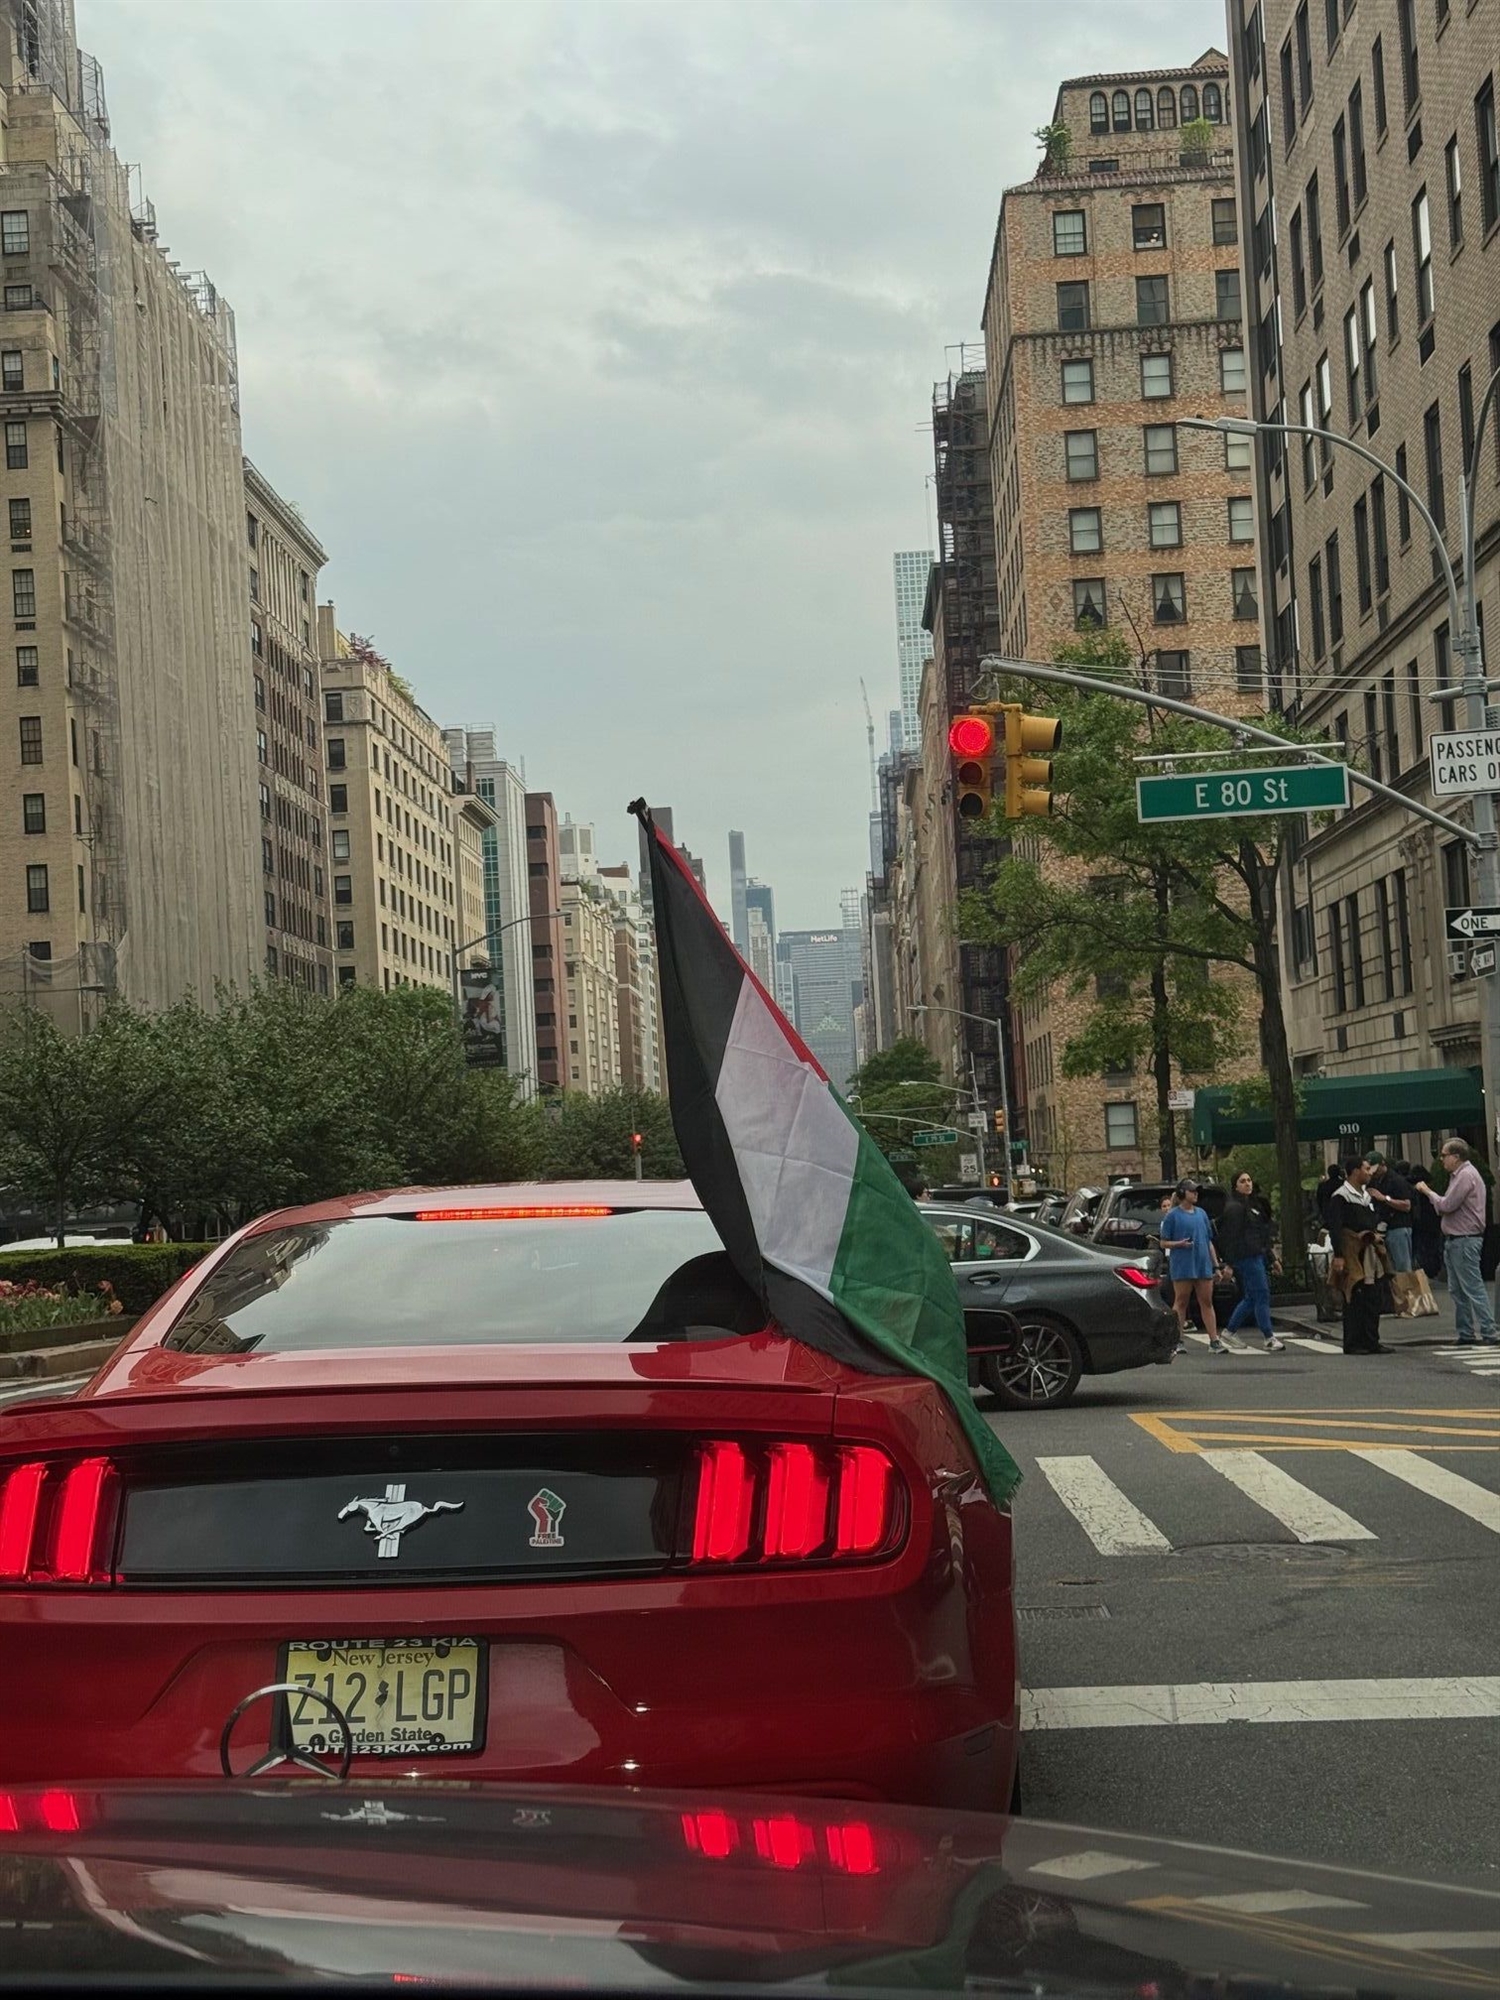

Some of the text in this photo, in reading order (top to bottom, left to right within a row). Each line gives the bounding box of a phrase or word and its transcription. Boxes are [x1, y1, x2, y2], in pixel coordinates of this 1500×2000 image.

[1438, 762, 1500, 784] CARS O
[1195, 778, 1289, 809] E 80 St
[1461, 917, 1489, 930] ONE
[810, 935, 838, 943] MetLife
[1339, 1123, 1360, 1134] 910
[963, 1165, 976, 1173] 25
[289, 1638, 477, 1651] ROUTE 23 KIA
[332, 1649, 435, 1669] New Jersey
[292, 1668, 471, 1725] Z12 LGP
[390, 1727, 432, 1741] State
[296, 1741, 472, 1755] OUTE23KIA.com
